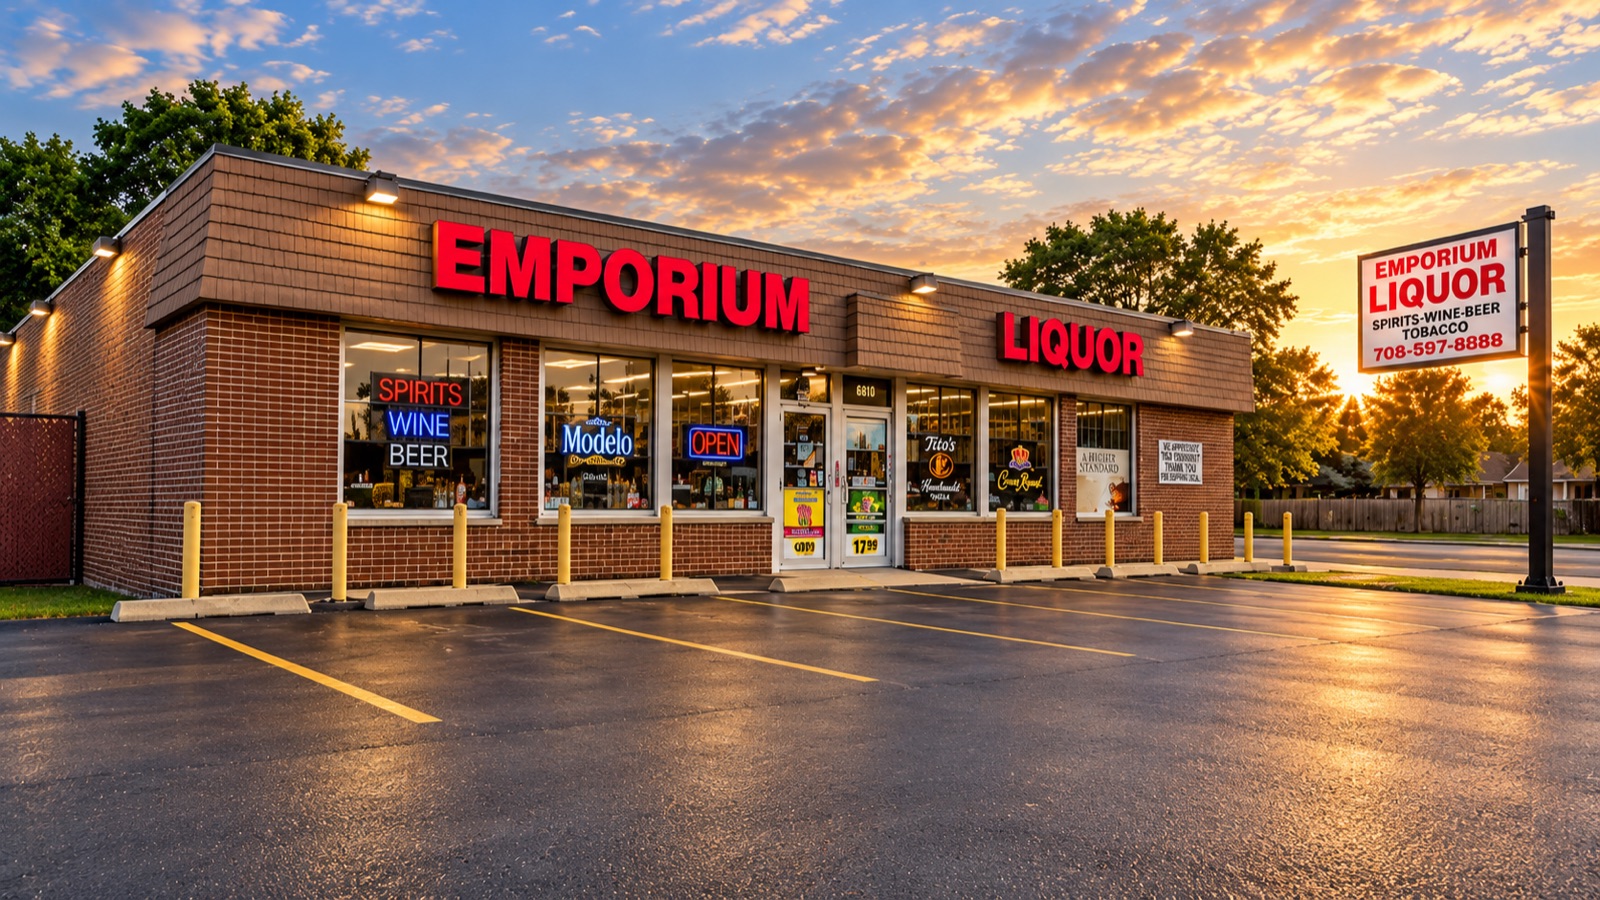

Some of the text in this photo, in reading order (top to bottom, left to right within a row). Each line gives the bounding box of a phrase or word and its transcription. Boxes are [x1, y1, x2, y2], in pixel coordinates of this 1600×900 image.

[1375, 238, 1497, 280] EMPORIUM
[432, 219, 810, 334] EMPORIUM
[1369, 262, 1506, 313] LIQUOR
[1372, 302, 1501, 331] SPIRITS-WINE-BEER
[1402, 320, 1469, 341] TOBACCO
[1001, 311, 1144, 377] LIQUOR
[1373, 332, 1503, 362] 708-597-8888
[378, 377, 463, 406] SPIRITS
[856, 385, 876, 398] 6810
[388, 411, 450, 438] WINE
[563, 424, 633, 456] Modelo
[692, 431, 739, 456] OPEN
[924, 435, 957, 452] Tito's
[390, 443, 449, 468] BEER
[1079, 462, 1119, 474] STANDARD
